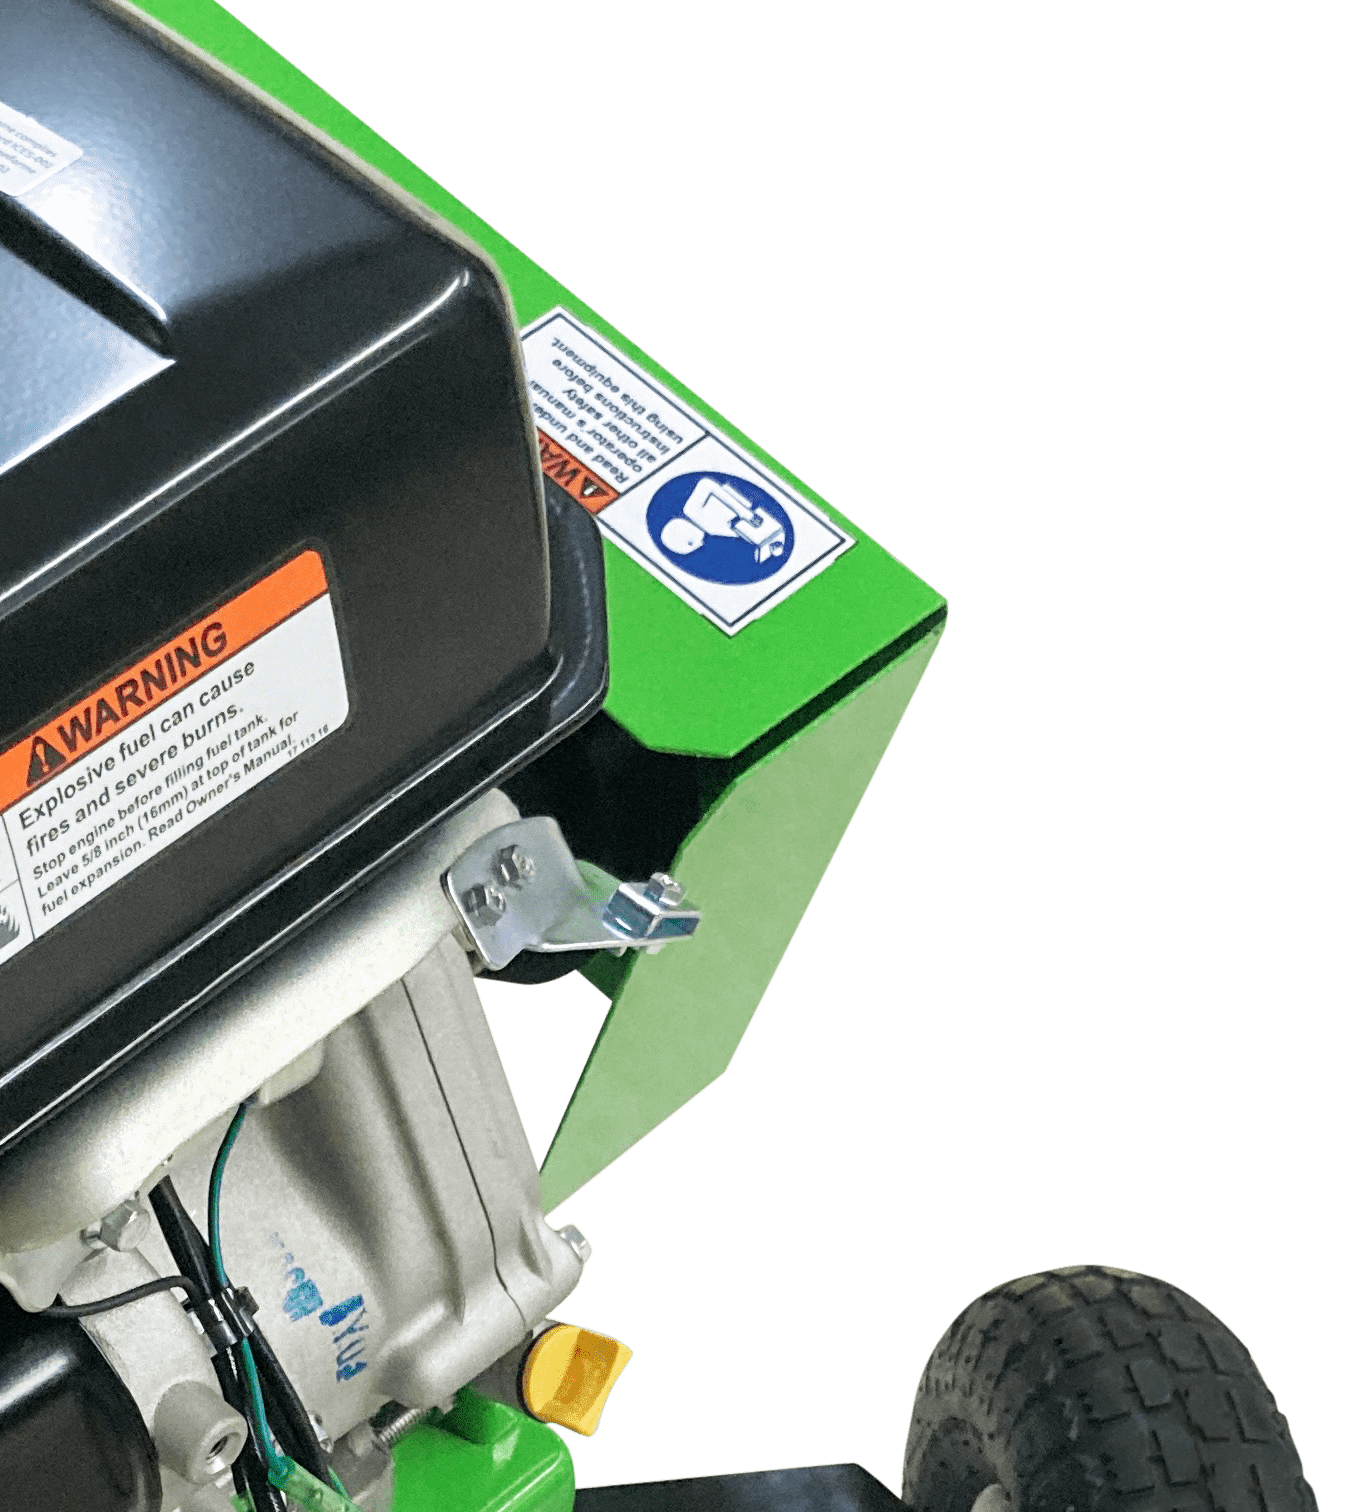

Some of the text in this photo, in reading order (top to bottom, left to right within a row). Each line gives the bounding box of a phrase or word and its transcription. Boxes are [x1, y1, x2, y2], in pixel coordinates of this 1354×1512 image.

[550, 336, 684, 445] using this equipment.
[551, 358, 671, 456] instructions before
[561, 388, 657, 464] all other safety
[564, 432, 595, 454] and
[590, 453, 630, 484] Read
[18, 661, 255, 831] Explosive fuel can cause
[57, 621, 228, 752] WARNING
[26, 704, 245, 858] fires and severe burns.
[32, 851, 66, 881] Stop
[68, 817, 116, 856] engine
[117, 785, 163, 822] before
[164, 755, 204, 789] filling
[205, 733, 232, 761] fuel
[36, 710, 299, 899] Leave 5/8 inch (16mm) at top of tank for
[41, 889, 69, 917] fuel
[147, 807, 184, 842] Read
[185, 771, 241, 815] Owner's
